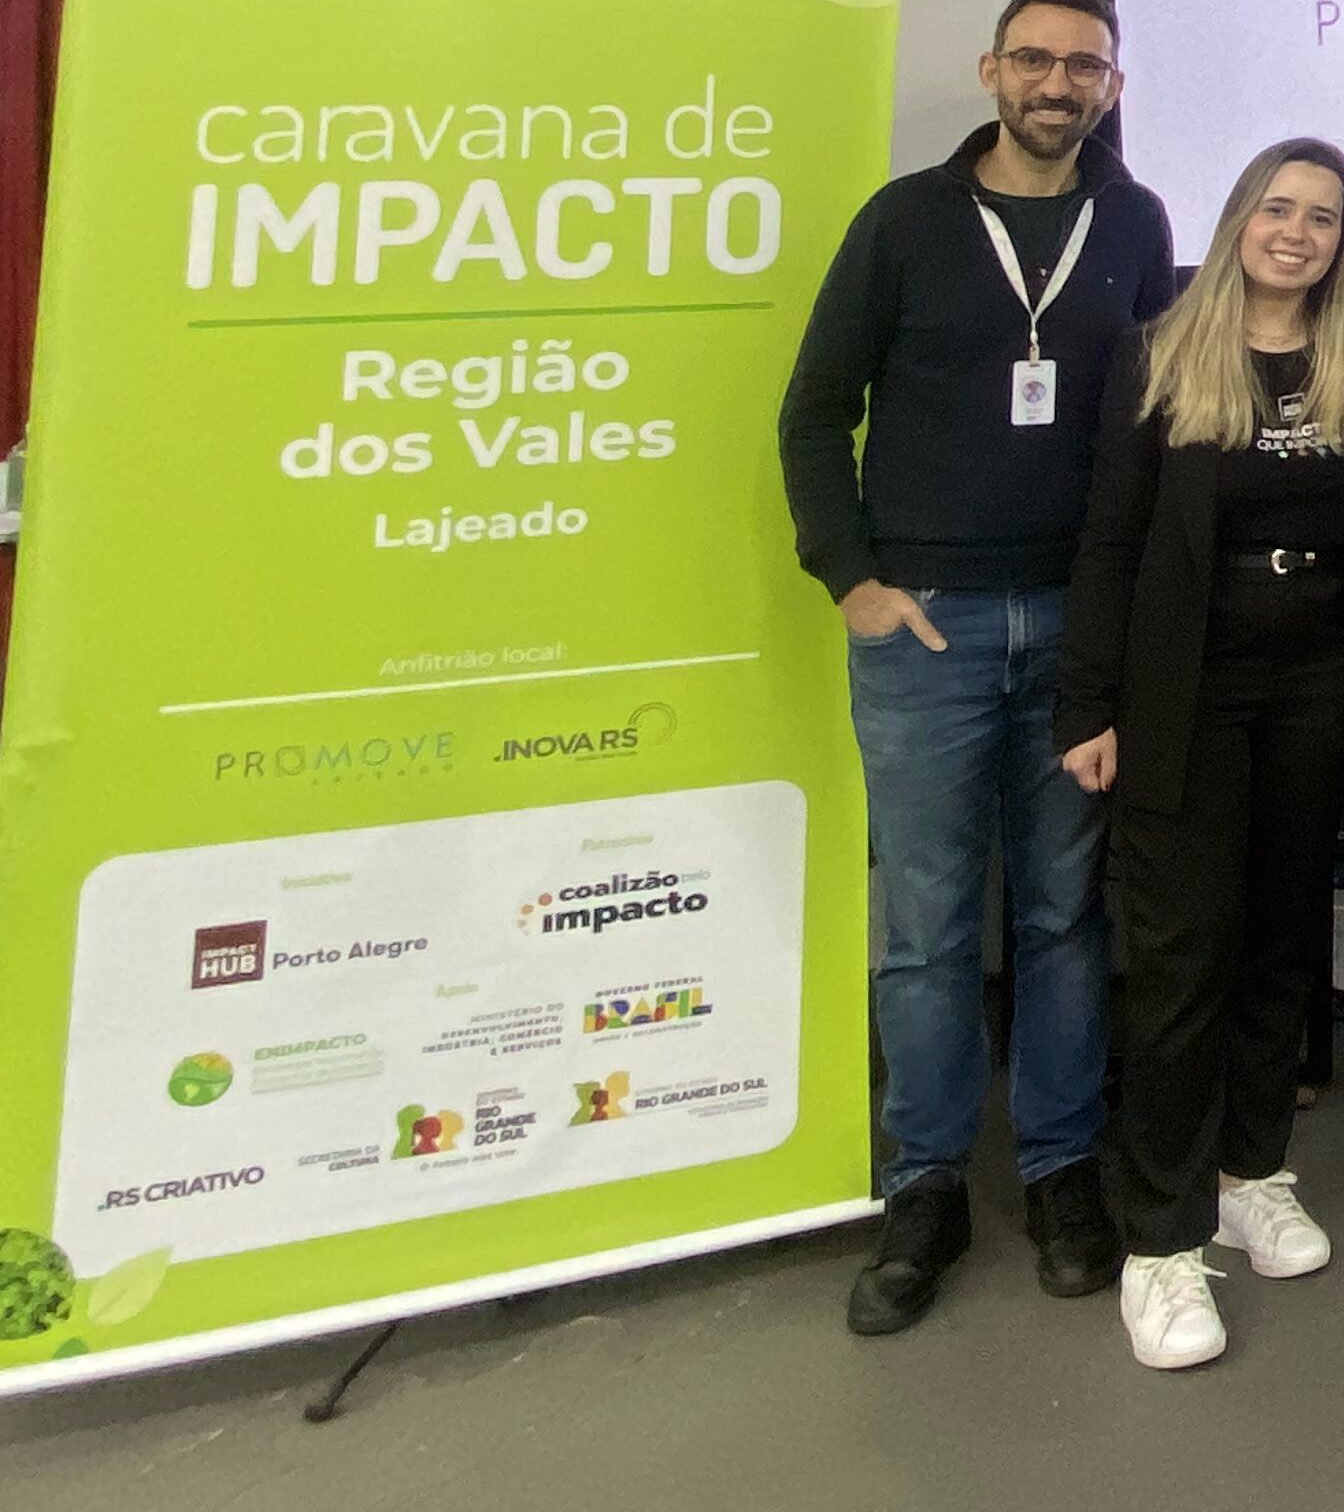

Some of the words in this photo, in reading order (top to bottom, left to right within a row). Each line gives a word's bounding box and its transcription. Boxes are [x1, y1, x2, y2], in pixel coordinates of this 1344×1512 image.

[196, 102, 629, 165] caravana
[664, 74, 775, 162] de
[185, 176, 783, 291] IMPACTO
[341, 338, 630, 412] Região
[280, 421, 433, 481] dos
[459, 410, 677, 470] Vales
[1261, 422, 1320, 439] IMPACT
[374, 501, 588, 553] Lajeado
[378, 650, 494, 677] Anfitrião
[214, 731, 456, 781] PROMOVE
[558, 870, 679, 902] coalizão
[541, 891, 709, 935] impacto
[199, 954, 257, 980] HUB
[272, 949, 342, 970] Porto
[347, 937, 429, 961] Alegre
[583, 987, 714, 1034] BRASIL
[720, 1081, 741, 1096] DO
[474, 1132, 497, 1147] DO
[143, 1165, 266, 1203] CRIATIVO
